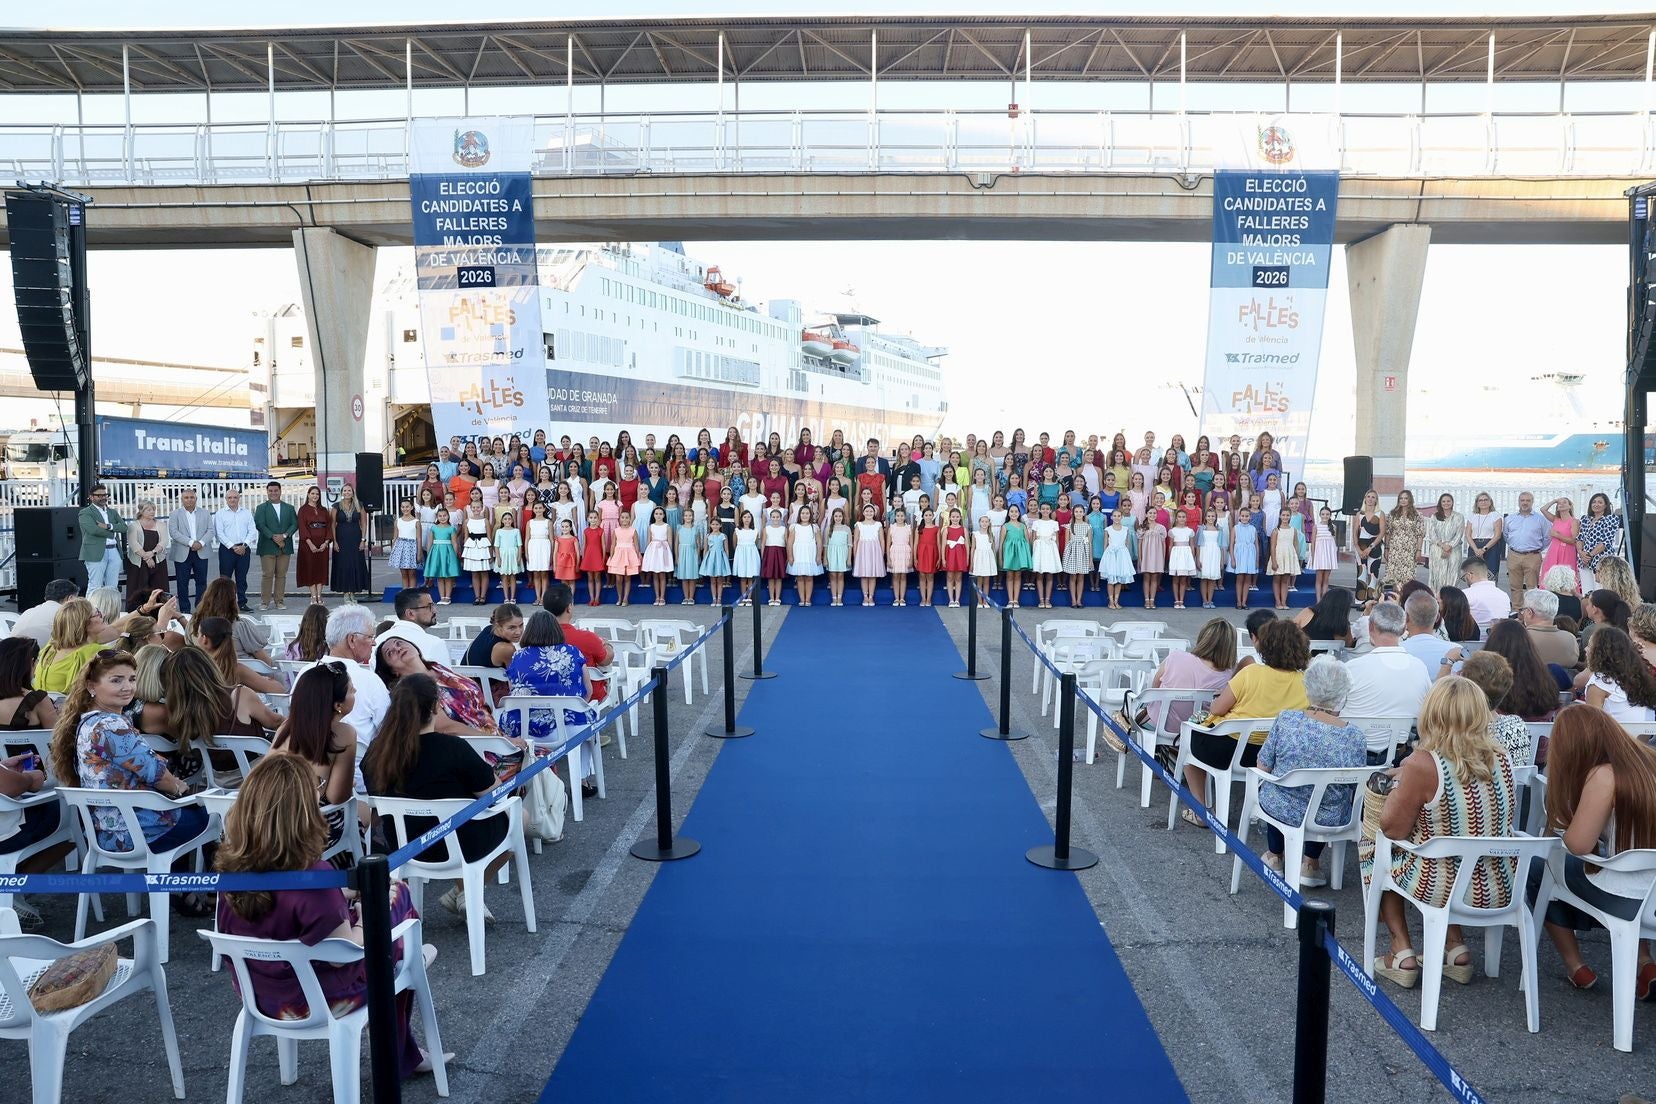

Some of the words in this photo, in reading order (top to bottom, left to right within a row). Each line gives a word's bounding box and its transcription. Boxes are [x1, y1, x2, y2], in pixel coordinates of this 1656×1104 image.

[440, 178, 500, 195] ELECCIÓ
[1246, 176, 1307, 193] ELECCIÓ
[421, 200, 509, 213] CANDIDATES
[512, 199, 522, 212] A
[1224, 197, 1313, 211] CANDIDATES
[1316, 198, 1326, 211] A
[436, 217, 508, 231] FALLERES
[1237, 216, 1309, 230] FALLERES
[443, 235, 503, 248] MAJORS
[1242, 234, 1301, 247] MAJORS
[430, 254, 447, 267] DE
[451, 250, 522, 266] VALÈNCIA
[1227, 252, 1245, 265] DE
[1248, 249, 1316, 265] VALÈNCIA
[460, 270, 492, 283] 2026
[1256, 271, 1288, 284] 2026
[569, 389, 580, 401] DE
[581, 391, 618, 404] GRANADA
[550, 404, 567, 412] SANTA
[568, 405, 580, 413] CRUZ
[588, 406, 608, 415] TENERIFE
[135, 429, 248, 456] TransItalia
[159, 873, 220, 885] Trasmed
[1268, 869, 1293, 898] Trasmed
[1344, 953, 1377, 996] Trasmed
